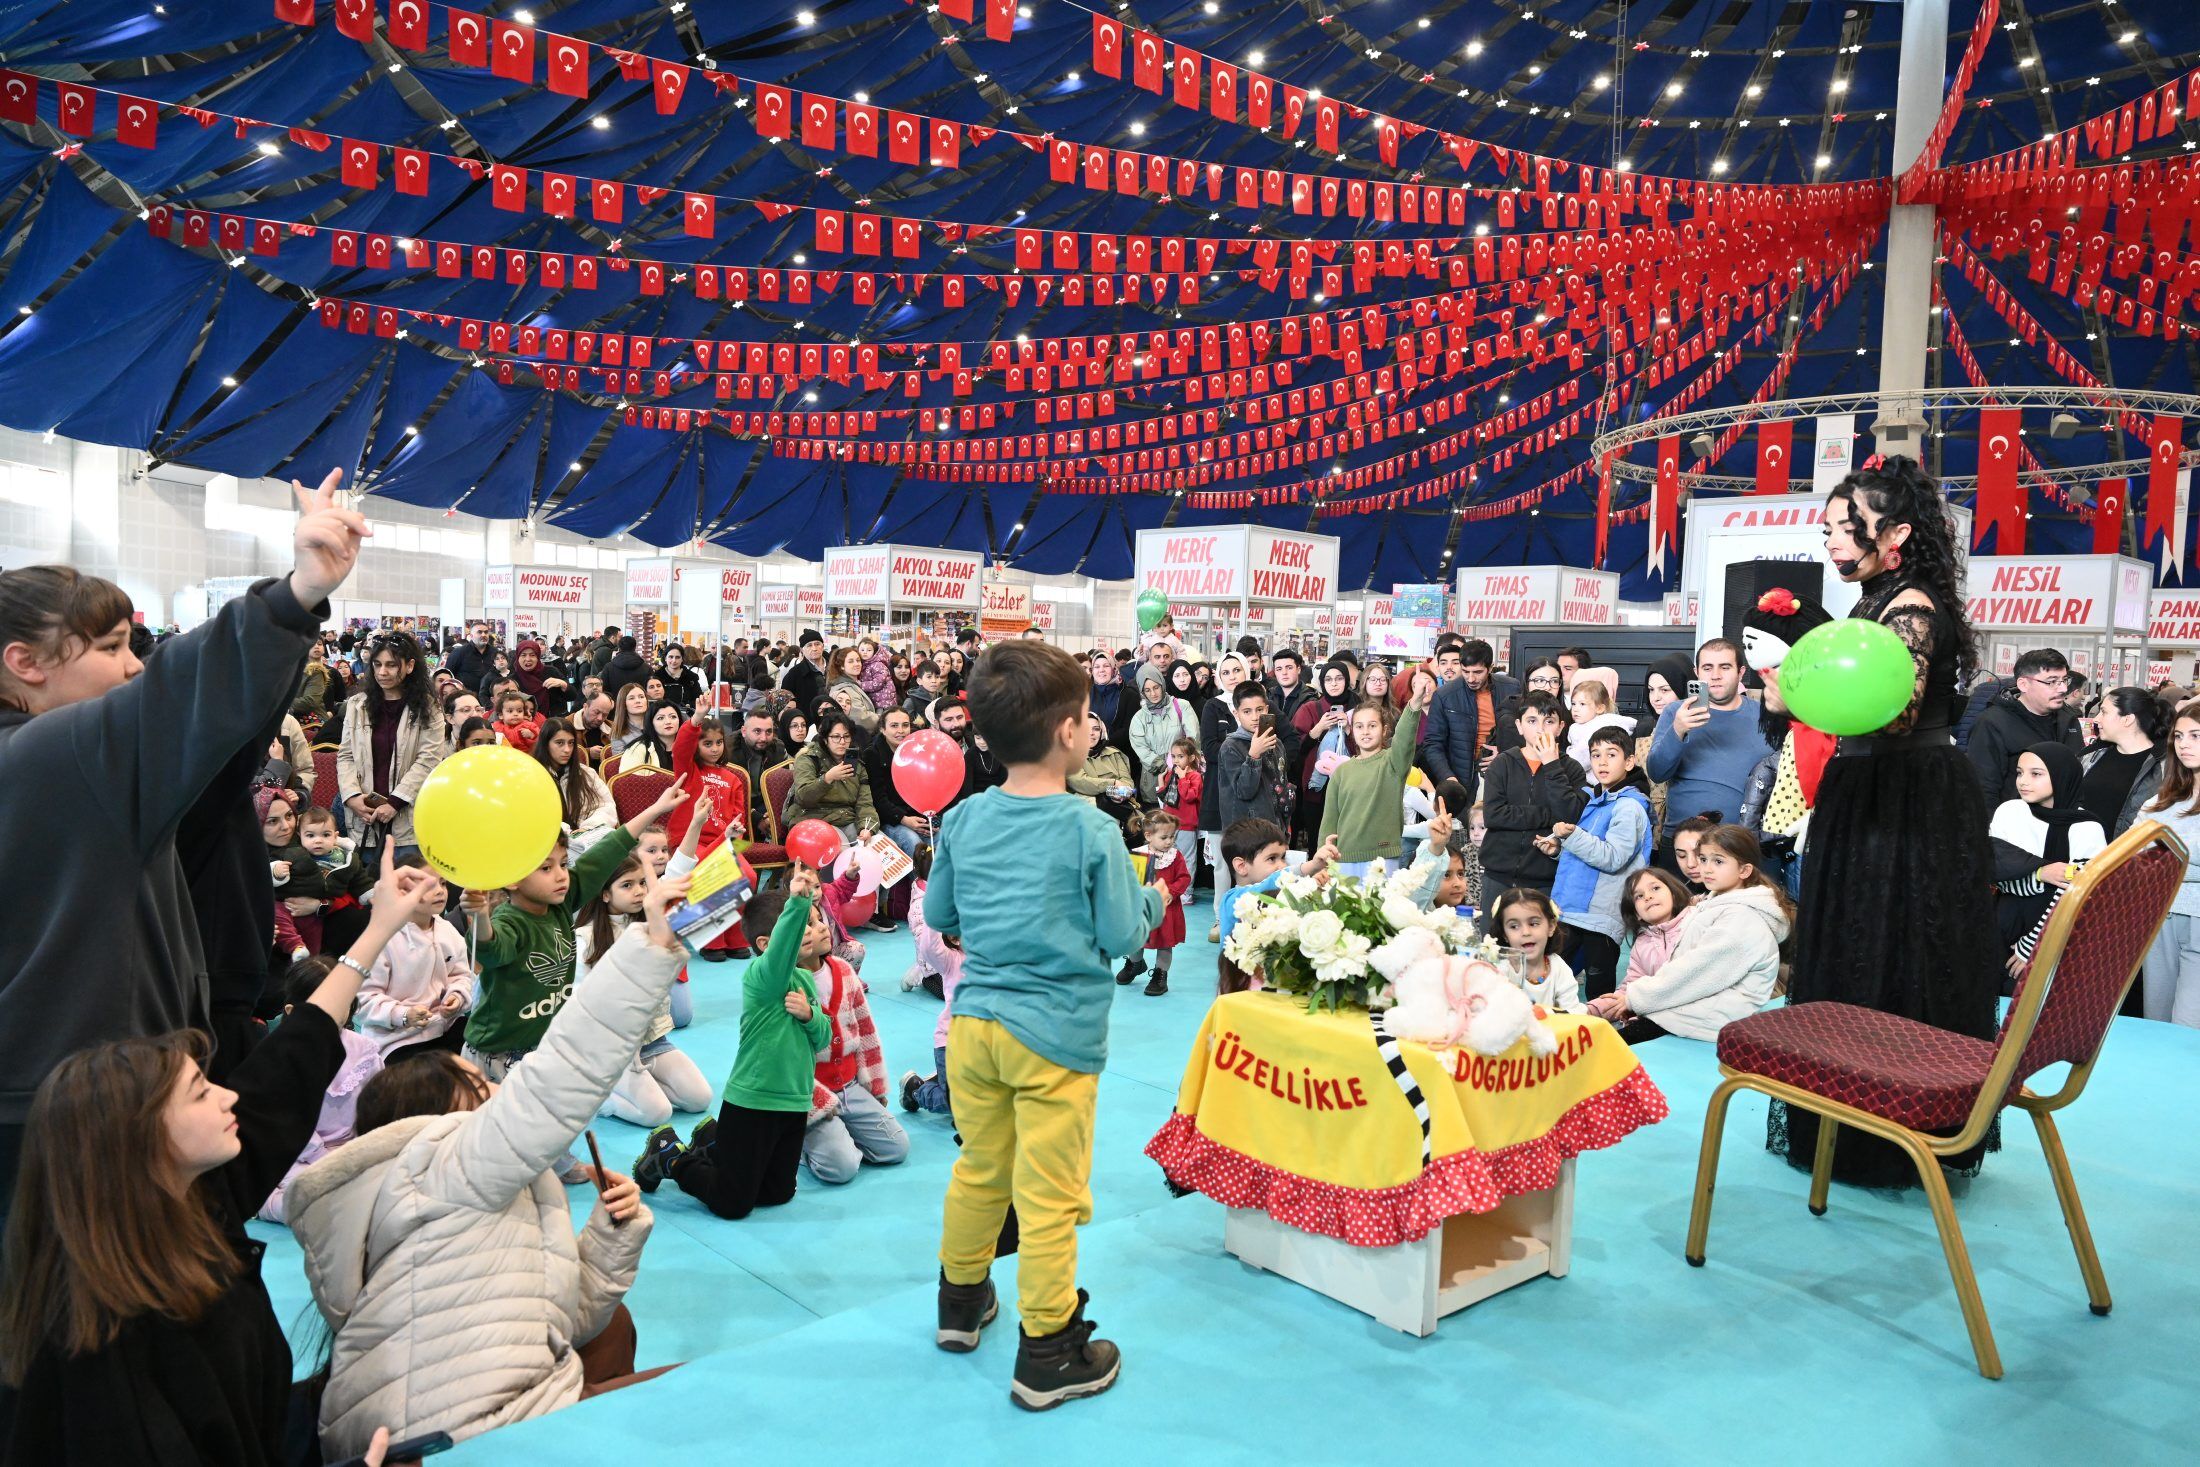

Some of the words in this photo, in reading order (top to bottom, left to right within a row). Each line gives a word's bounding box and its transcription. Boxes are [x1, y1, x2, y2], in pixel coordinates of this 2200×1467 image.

[829, 558, 855, 575] AKYOL
[858, 557, 886, 575] SAHAF
[893, 557, 932, 577] AKYOL
[936, 561, 976, 580] SAHAF
[520, 573, 567, 587] MODUNU
[569, 576, 588, 590] SEÇ
[722, 569, 751, 586] ÖĞÜT
[1147, 568, 1234, 594] YAYINLARI
[1253, 570, 1325, 601] YAYINLARI
[529, 589, 580, 602] YAYINLARI
[633, 585, 662, 598] YAYINLARI
[834, 579, 877, 596] YAYINLARI
[903, 579, 965, 599] YAYINLARI
[1168, 604, 1200, 617] INLARI
[1336, 614, 1358, 625] ÜLBEY
[1467, 600, 1545, 620] YAYINLARI
[1563, 601, 1608, 623] YAYINLARI
[1964, 598, 2093, 625] YAYINLARI
[1215, 1031, 1367, 1111] ÜZELLİKLE
